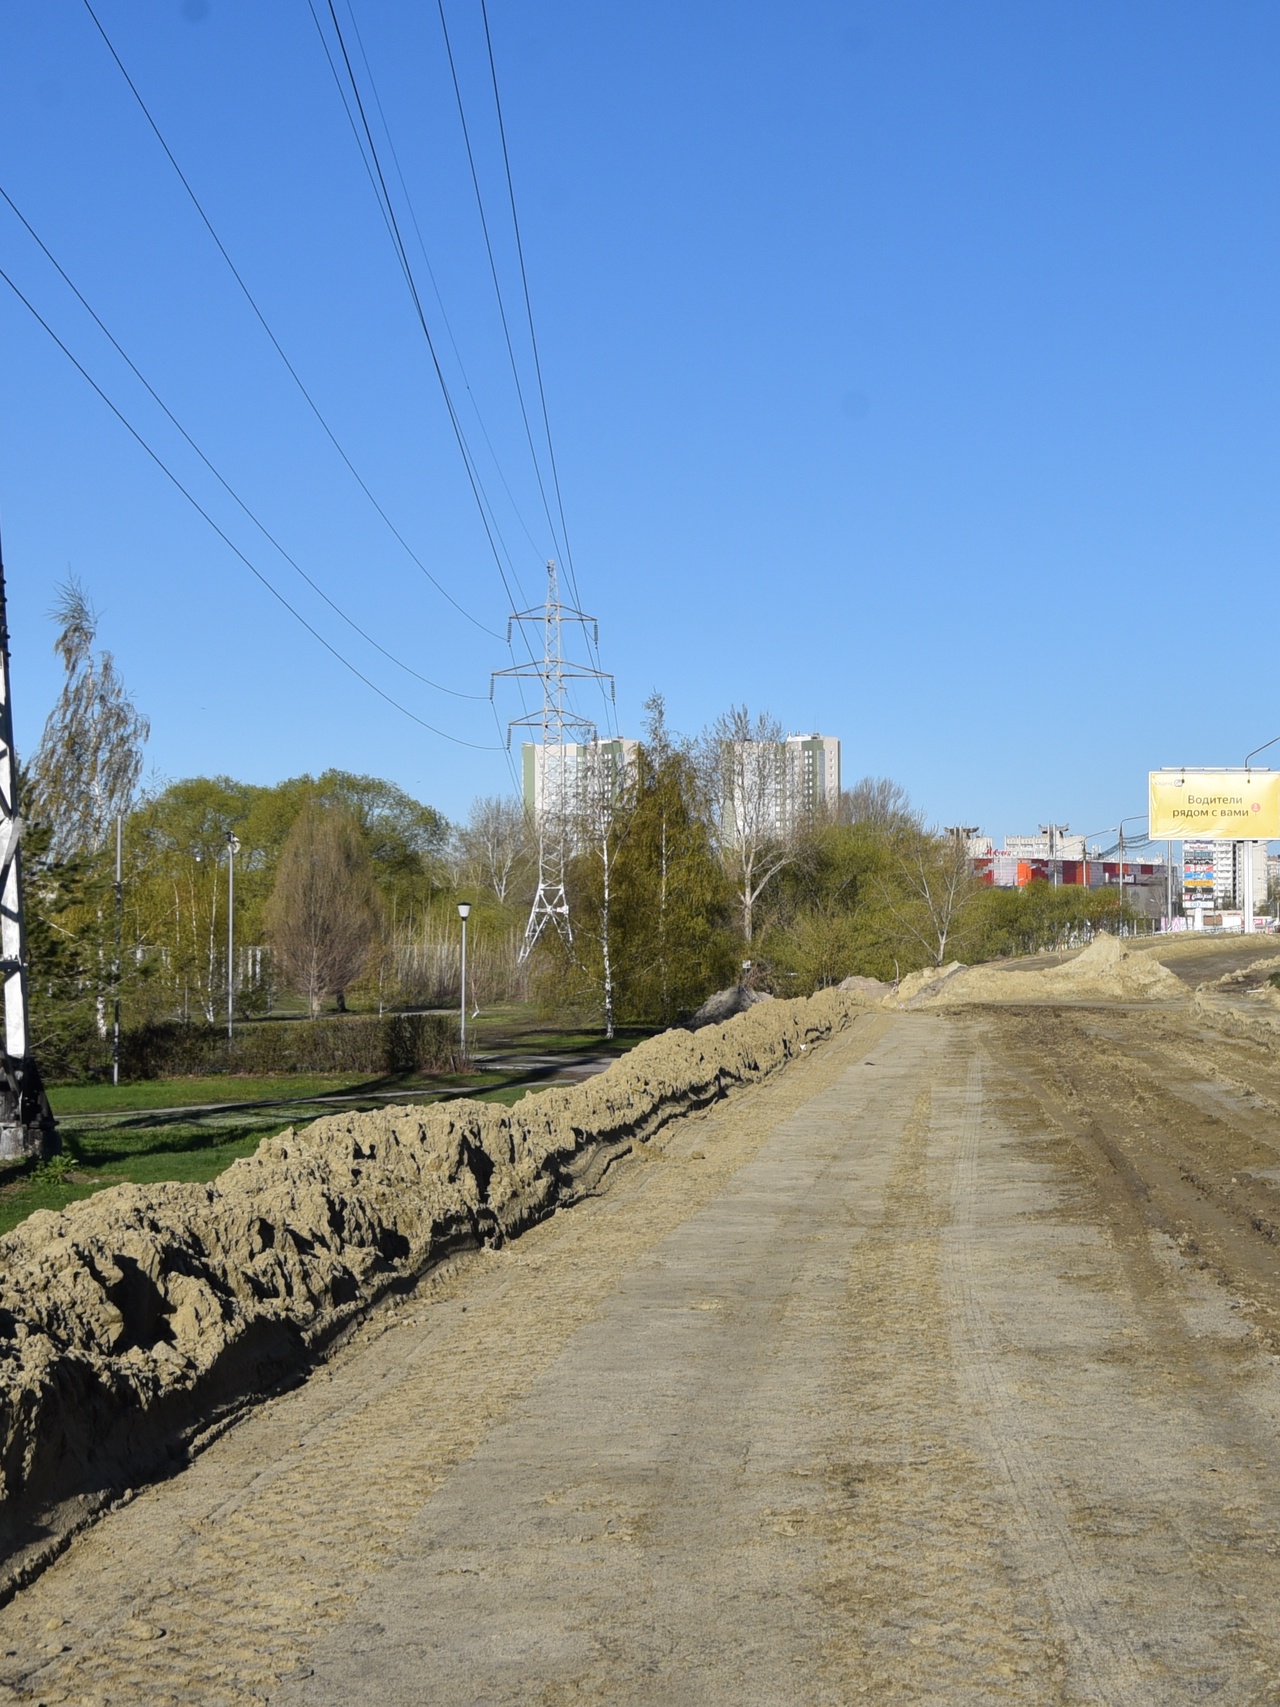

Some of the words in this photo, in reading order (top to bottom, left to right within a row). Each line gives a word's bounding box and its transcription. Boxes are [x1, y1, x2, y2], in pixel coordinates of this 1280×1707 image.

[1188, 794, 1243, 805] Водители
[1172, 809, 1209, 818] рядом
[1211, 809, 1218, 817] с
[1220, 809, 1249, 817] вами
